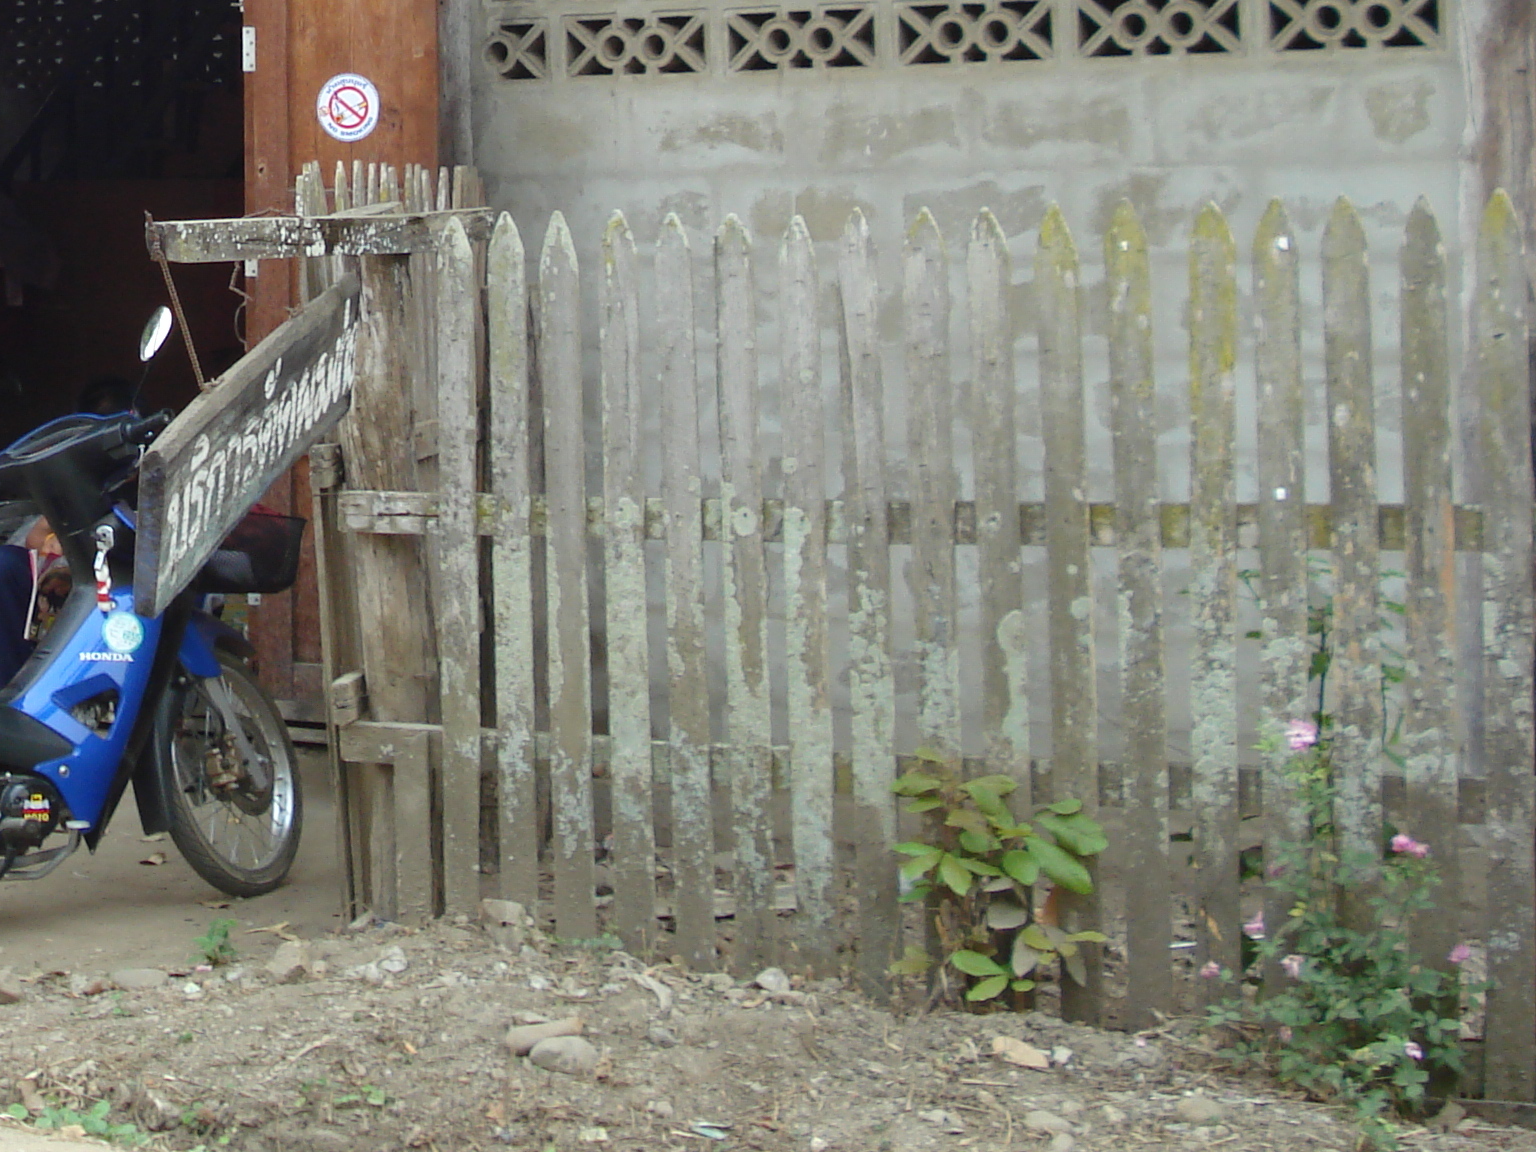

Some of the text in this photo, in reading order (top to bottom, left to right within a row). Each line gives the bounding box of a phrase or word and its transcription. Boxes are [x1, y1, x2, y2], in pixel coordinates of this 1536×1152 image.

[327, 116, 374, 136] NO SMOKING
[79, 651, 134, 662] HONDA
